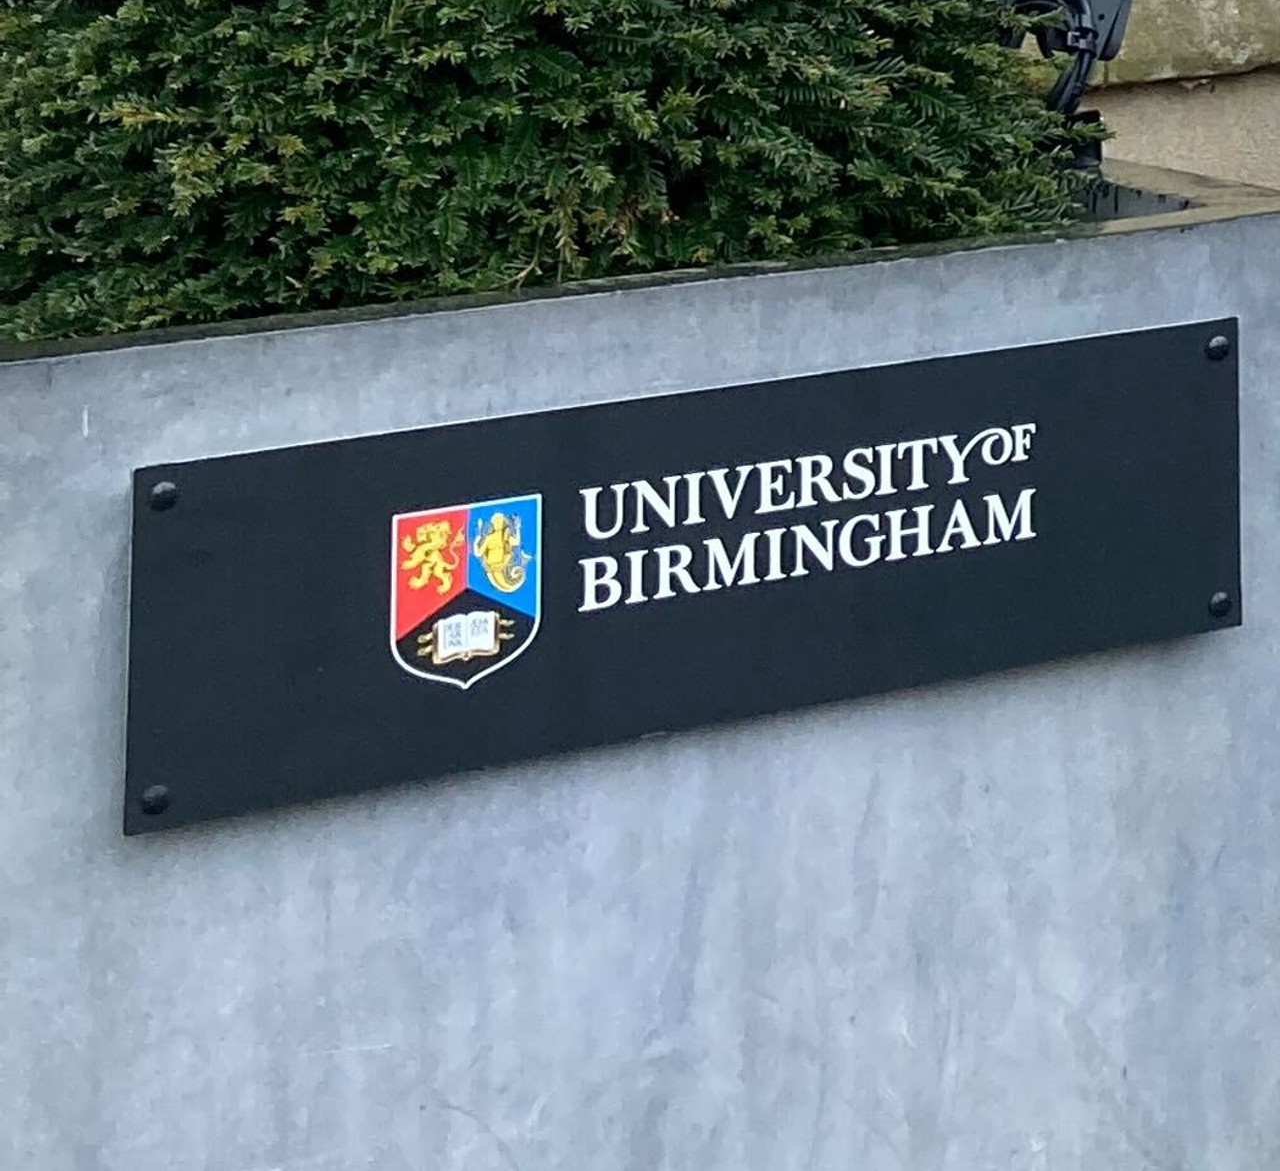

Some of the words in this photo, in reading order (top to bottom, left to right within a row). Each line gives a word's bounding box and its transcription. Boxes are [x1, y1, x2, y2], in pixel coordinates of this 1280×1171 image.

[579, 427, 990, 539] UNIVERSITY
[981, 423, 1036, 465] OF
[577, 488, 1037, 612] BIRMINGHAM
